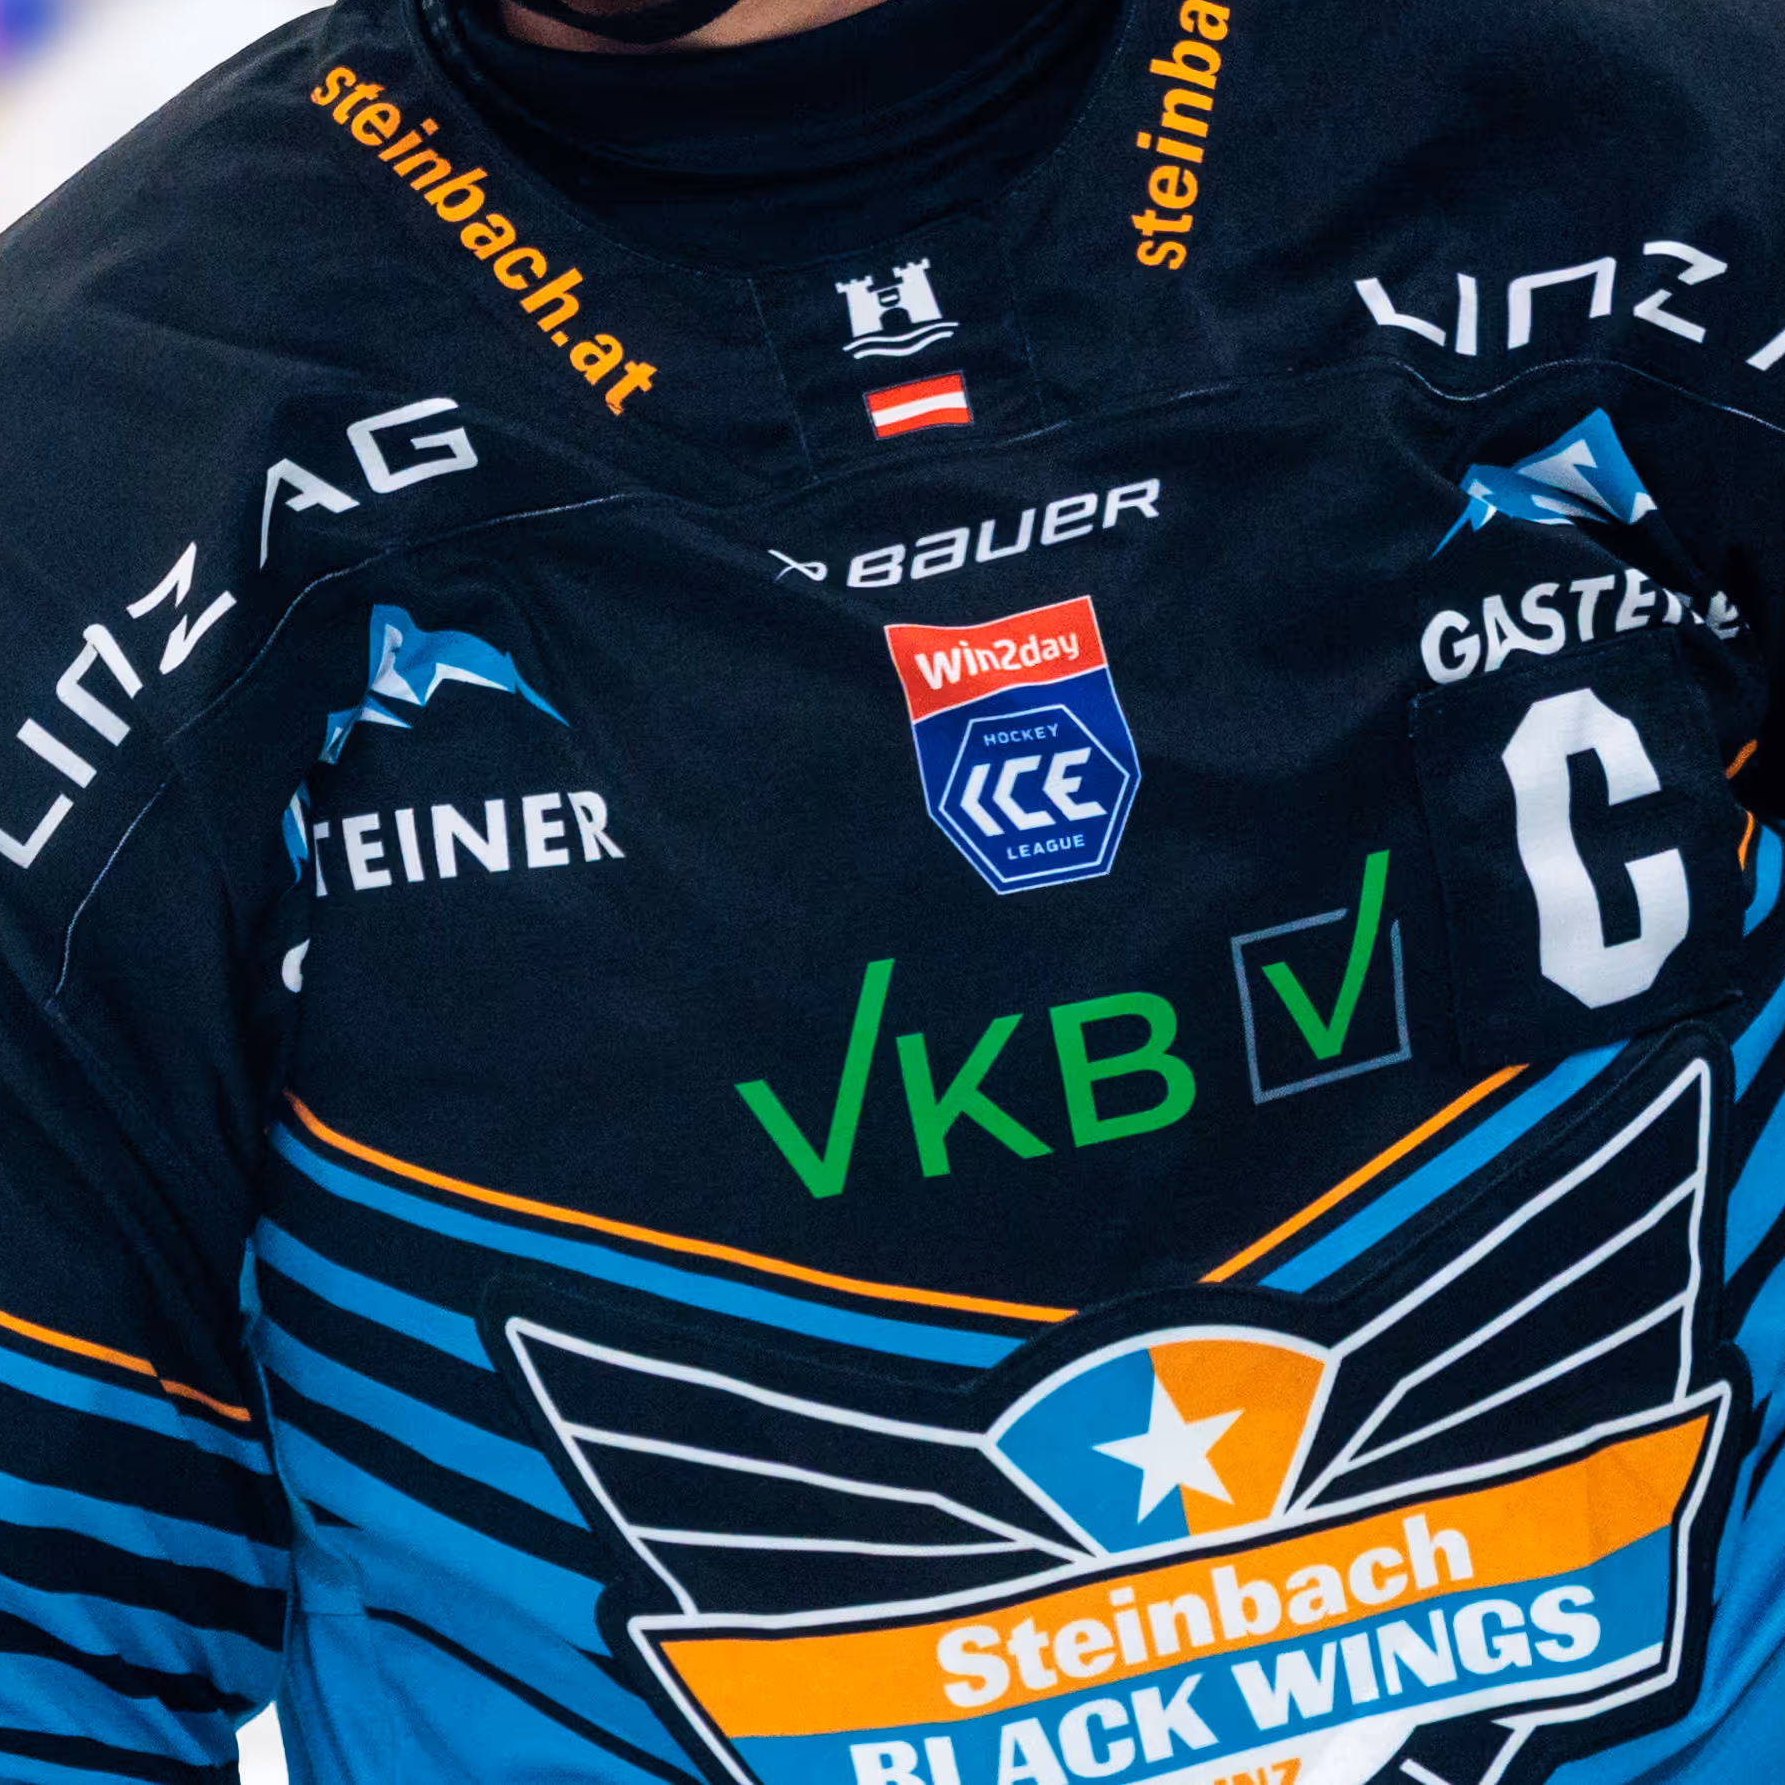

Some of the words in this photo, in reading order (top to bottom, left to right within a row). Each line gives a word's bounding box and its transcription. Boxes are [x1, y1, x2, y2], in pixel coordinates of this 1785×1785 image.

[309, 64, 658, 417] steinbach.at
[1353, 239, 1729, 357] LINZ
[258, 396, 479, 570] AG
[845, 477, 1161, 589] BAUER
[915, 632, 1081, 692] Win2day
[960, 745, 1109, 838] ICE
[983, 722, 1060, 748] HOCKEY
[312, 790, 626, 897] TEINER
[1007, 833, 1086, 861] LEAGUE
[1501, 687, 1691, 1010] C
[733, 957, 1198, 1199] VKB
[935, 1513, 1476, 1709] Steinbach
[1229, 1584, 1603, 1732] WINGS
